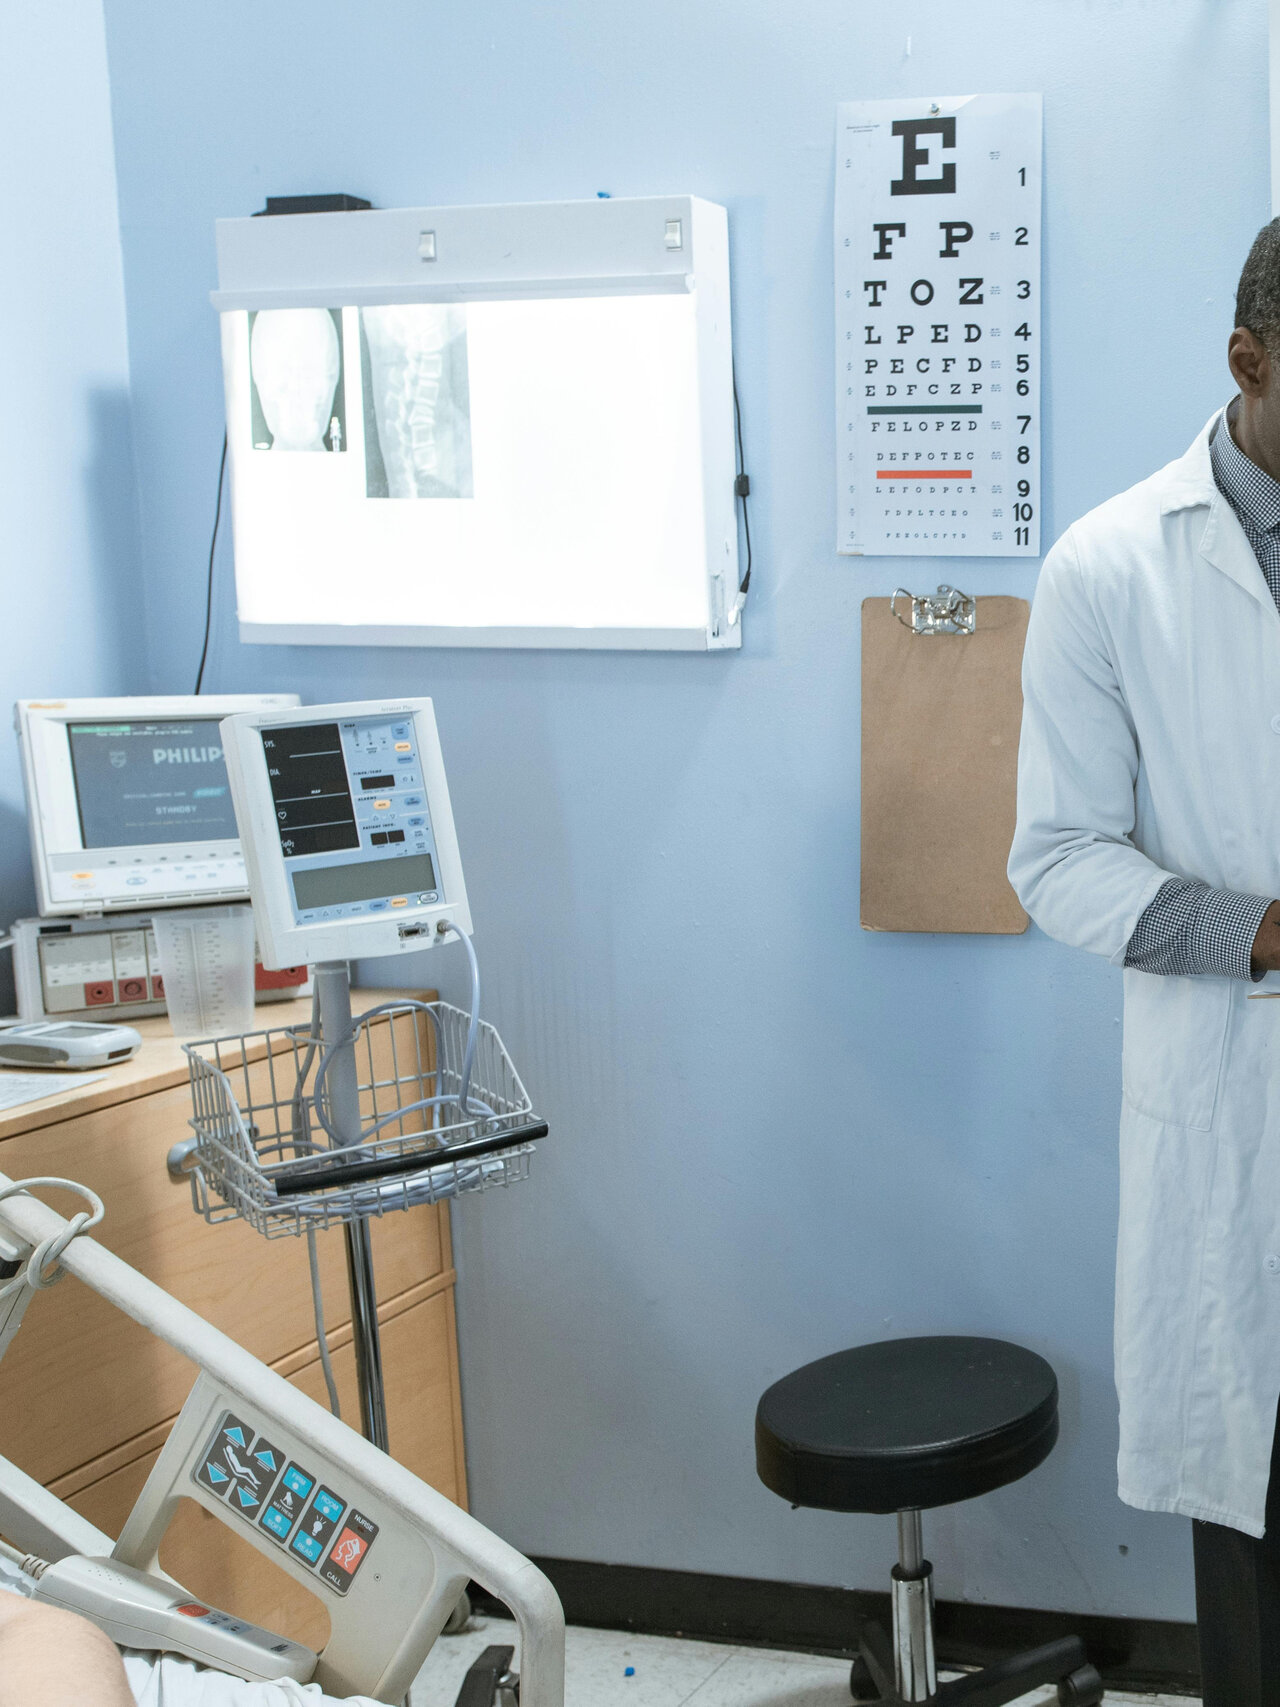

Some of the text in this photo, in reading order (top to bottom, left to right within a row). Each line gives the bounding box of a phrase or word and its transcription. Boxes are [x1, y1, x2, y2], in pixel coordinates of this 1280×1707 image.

[890, 116, 956, 196] E
[1018, 167, 1026, 187] 1
[1015, 227, 1029, 245] 2
[1017, 280, 1031, 299] 3
[1014, 322, 1032, 341] 4
[1016, 354, 1030, 373] 5
[1016, 379, 1030, 397] 6
[1016, 415, 1032, 434] 7
[1016, 446, 1030, 464] 8
[1016, 479, 1030, 497] 9
[1012, 503, 1033, 521] 10
[1014, 527, 1029, 546] 11
[153, 746, 226, 765] PHILIP
[155, 804, 198, 815] STANDBY
[273, 1501, 294, 1519] MATTRESS
[321, 1495, 339, 1511] ROOM
[354, 1514, 375, 1533] NURSE
[297, 1542, 314, 1557] READ
[326, 1571, 342, 1586] CALL
